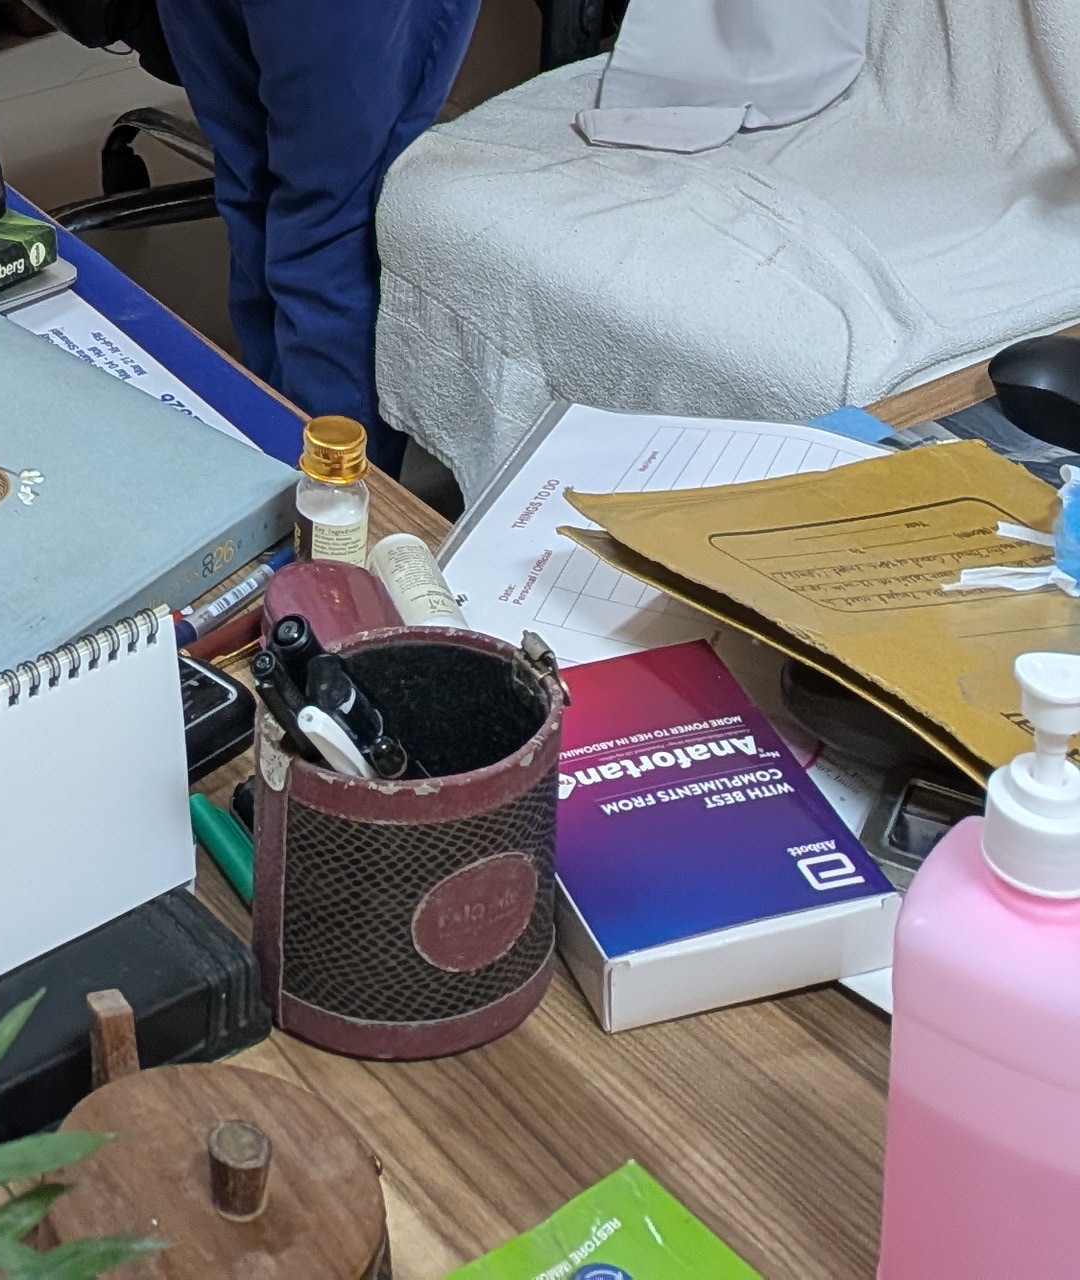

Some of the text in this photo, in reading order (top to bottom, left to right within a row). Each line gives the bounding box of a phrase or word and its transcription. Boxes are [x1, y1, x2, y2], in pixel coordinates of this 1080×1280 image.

[511, 478, 561, 530] THINGS TO DO
[512, 548, 554, 606] Personal Official
[498, 584, 517, 603] Date:
[669, 720, 709, 735] POWER
[709, 715, 743, 728] MORE
[615, 736, 628, 746] IN
[629, 731, 652, 744] HER
[654, 728, 669, 738] TO
[573, 735, 758, 788] Anafortan
[599, 768, 783, 817] COMPLIMENTS FROM
[704, 782, 796, 810] WITH BEST
[786, 839, 837, 858] Abbott
[568, 1217, 622, 1265] RESTORE
